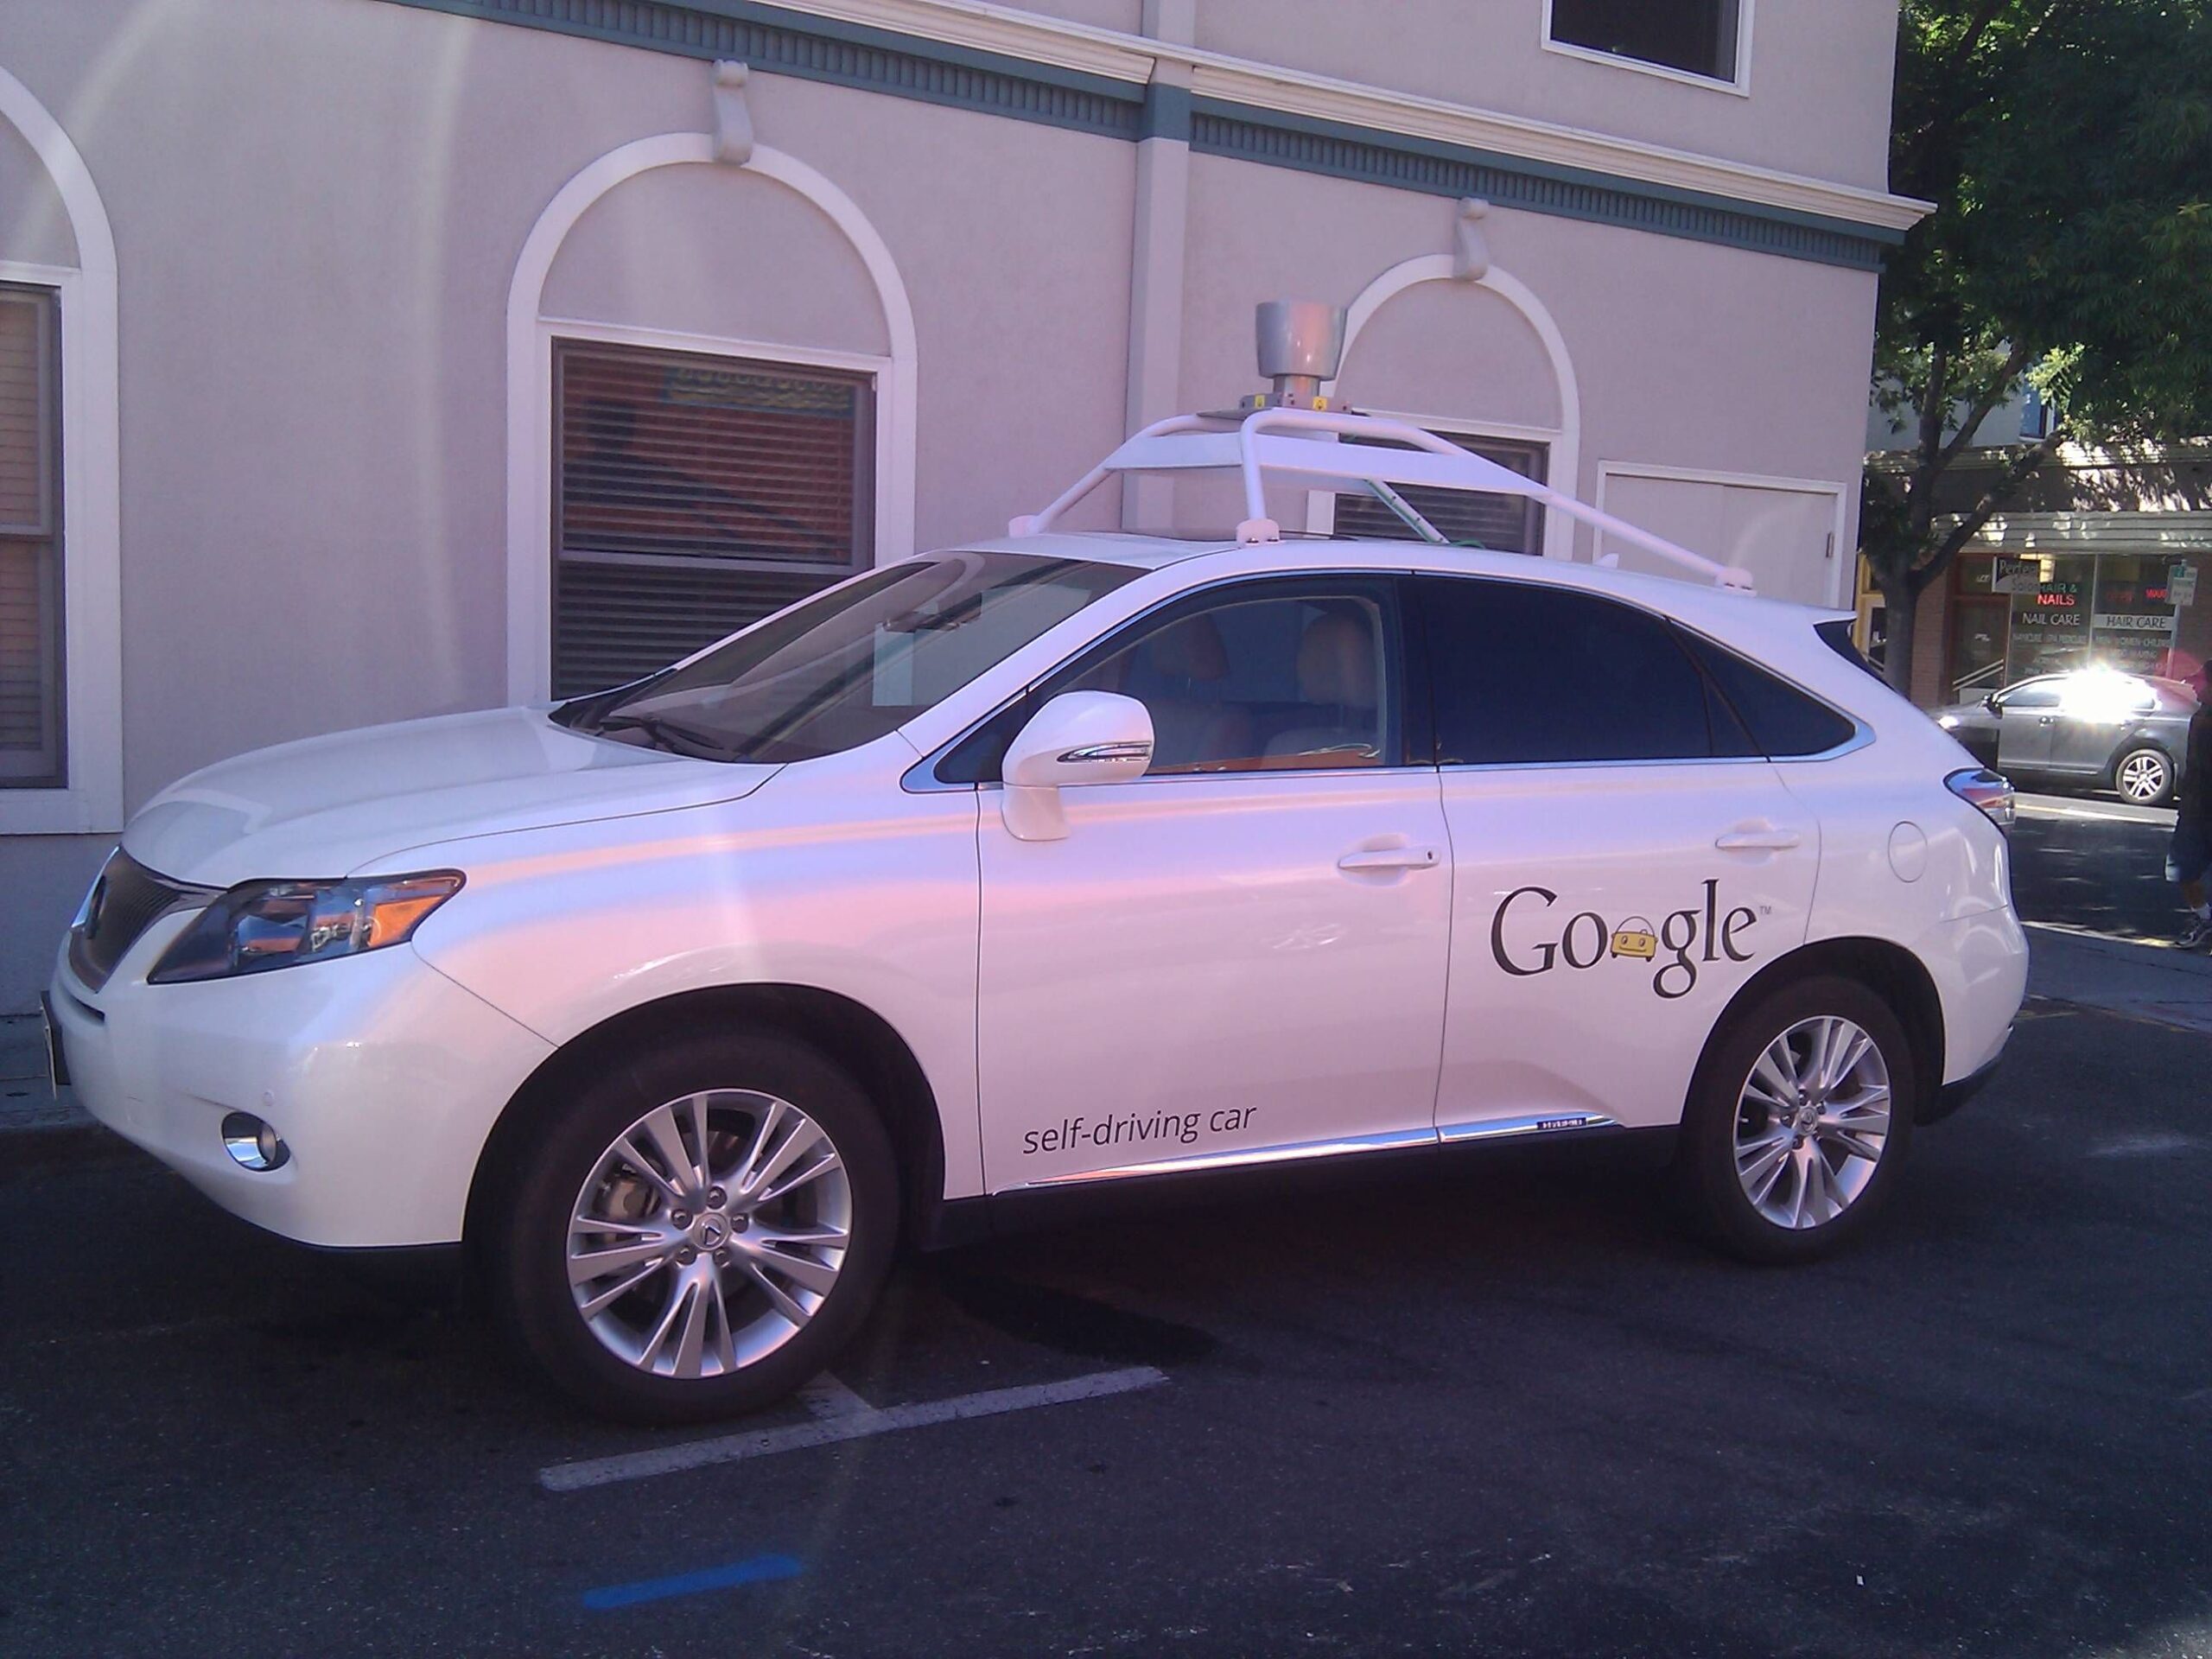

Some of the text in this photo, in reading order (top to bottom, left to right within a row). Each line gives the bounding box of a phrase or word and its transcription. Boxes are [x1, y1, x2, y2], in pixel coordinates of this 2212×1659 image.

[2037, 594, 2075, 606] NAILS
[2022, 613, 2081, 626] NAIL CARE
[2106, 616, 2166, 629] HAIR CARE
[1023, 1105, 1256, 1154] self-driving car
